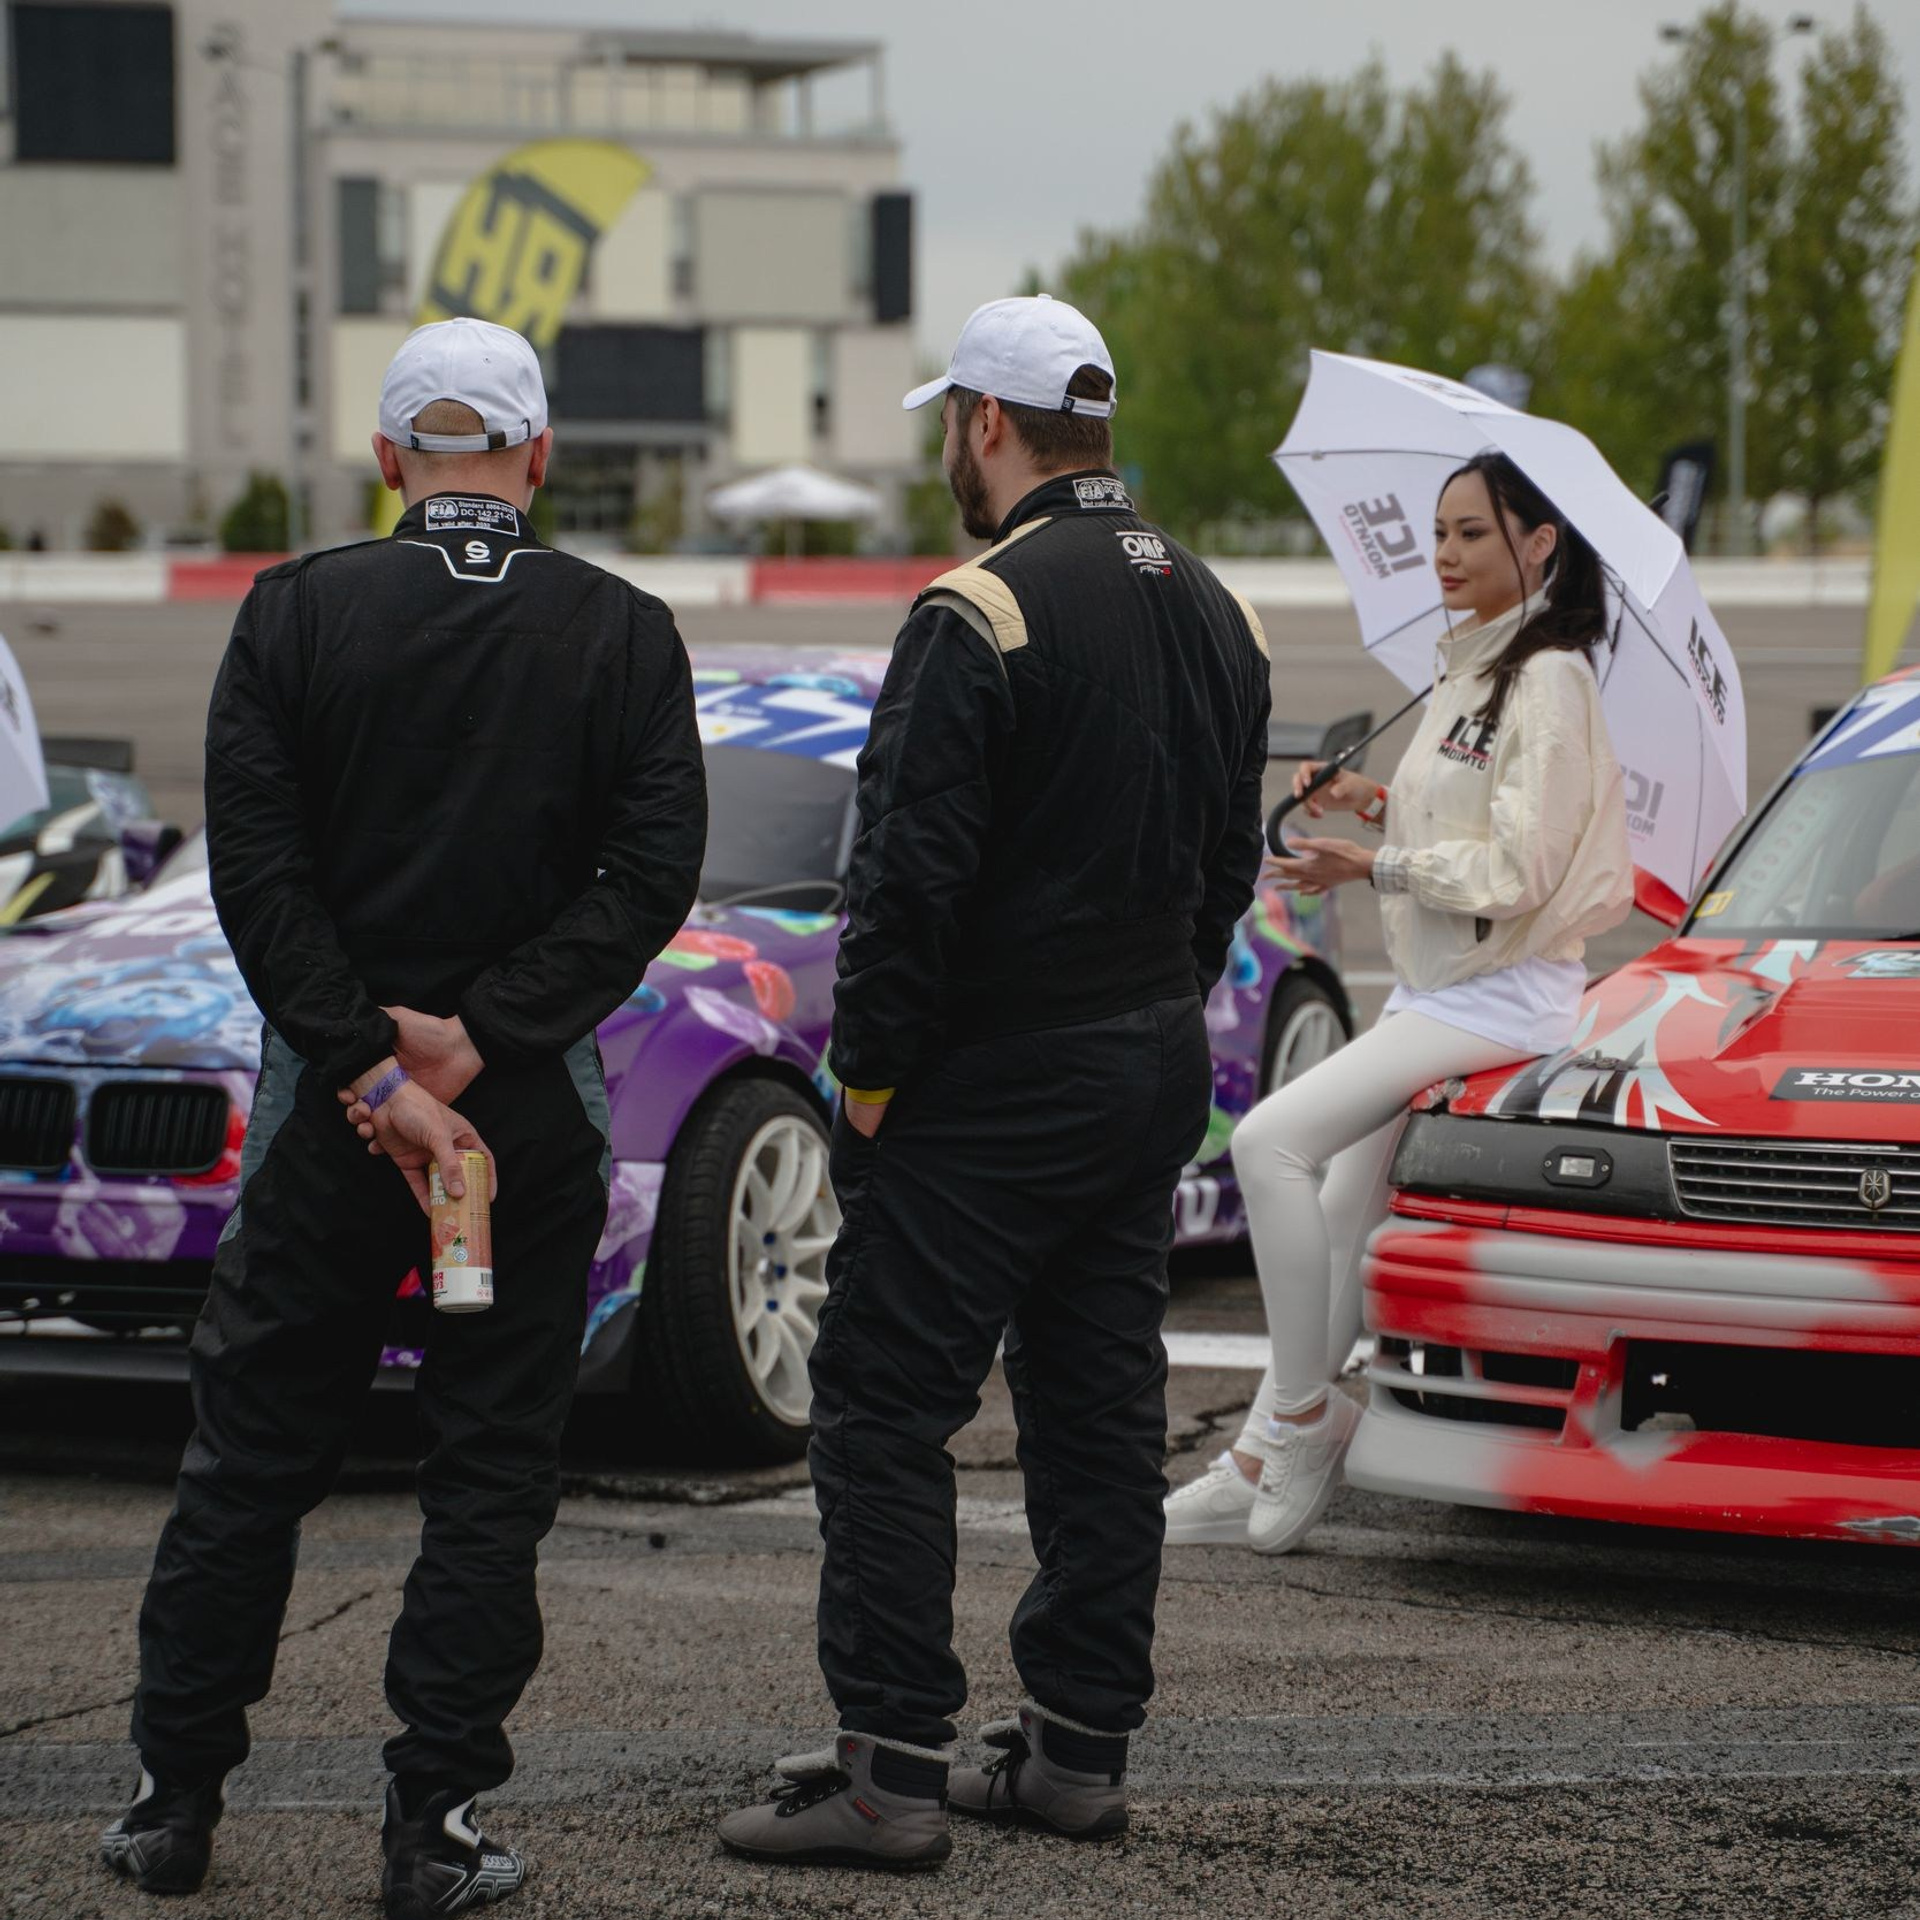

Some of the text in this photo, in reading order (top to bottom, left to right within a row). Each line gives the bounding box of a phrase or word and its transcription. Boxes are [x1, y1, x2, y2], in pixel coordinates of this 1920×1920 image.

[1080, 485, 1103, 499] FIA
[1122, 536, 1166, 559] OMP
[1690, 616, 1728, 715] ICE
[1812, 1088, 1844, 1096] The
[1849, 1088, 1906, 1098] Power
